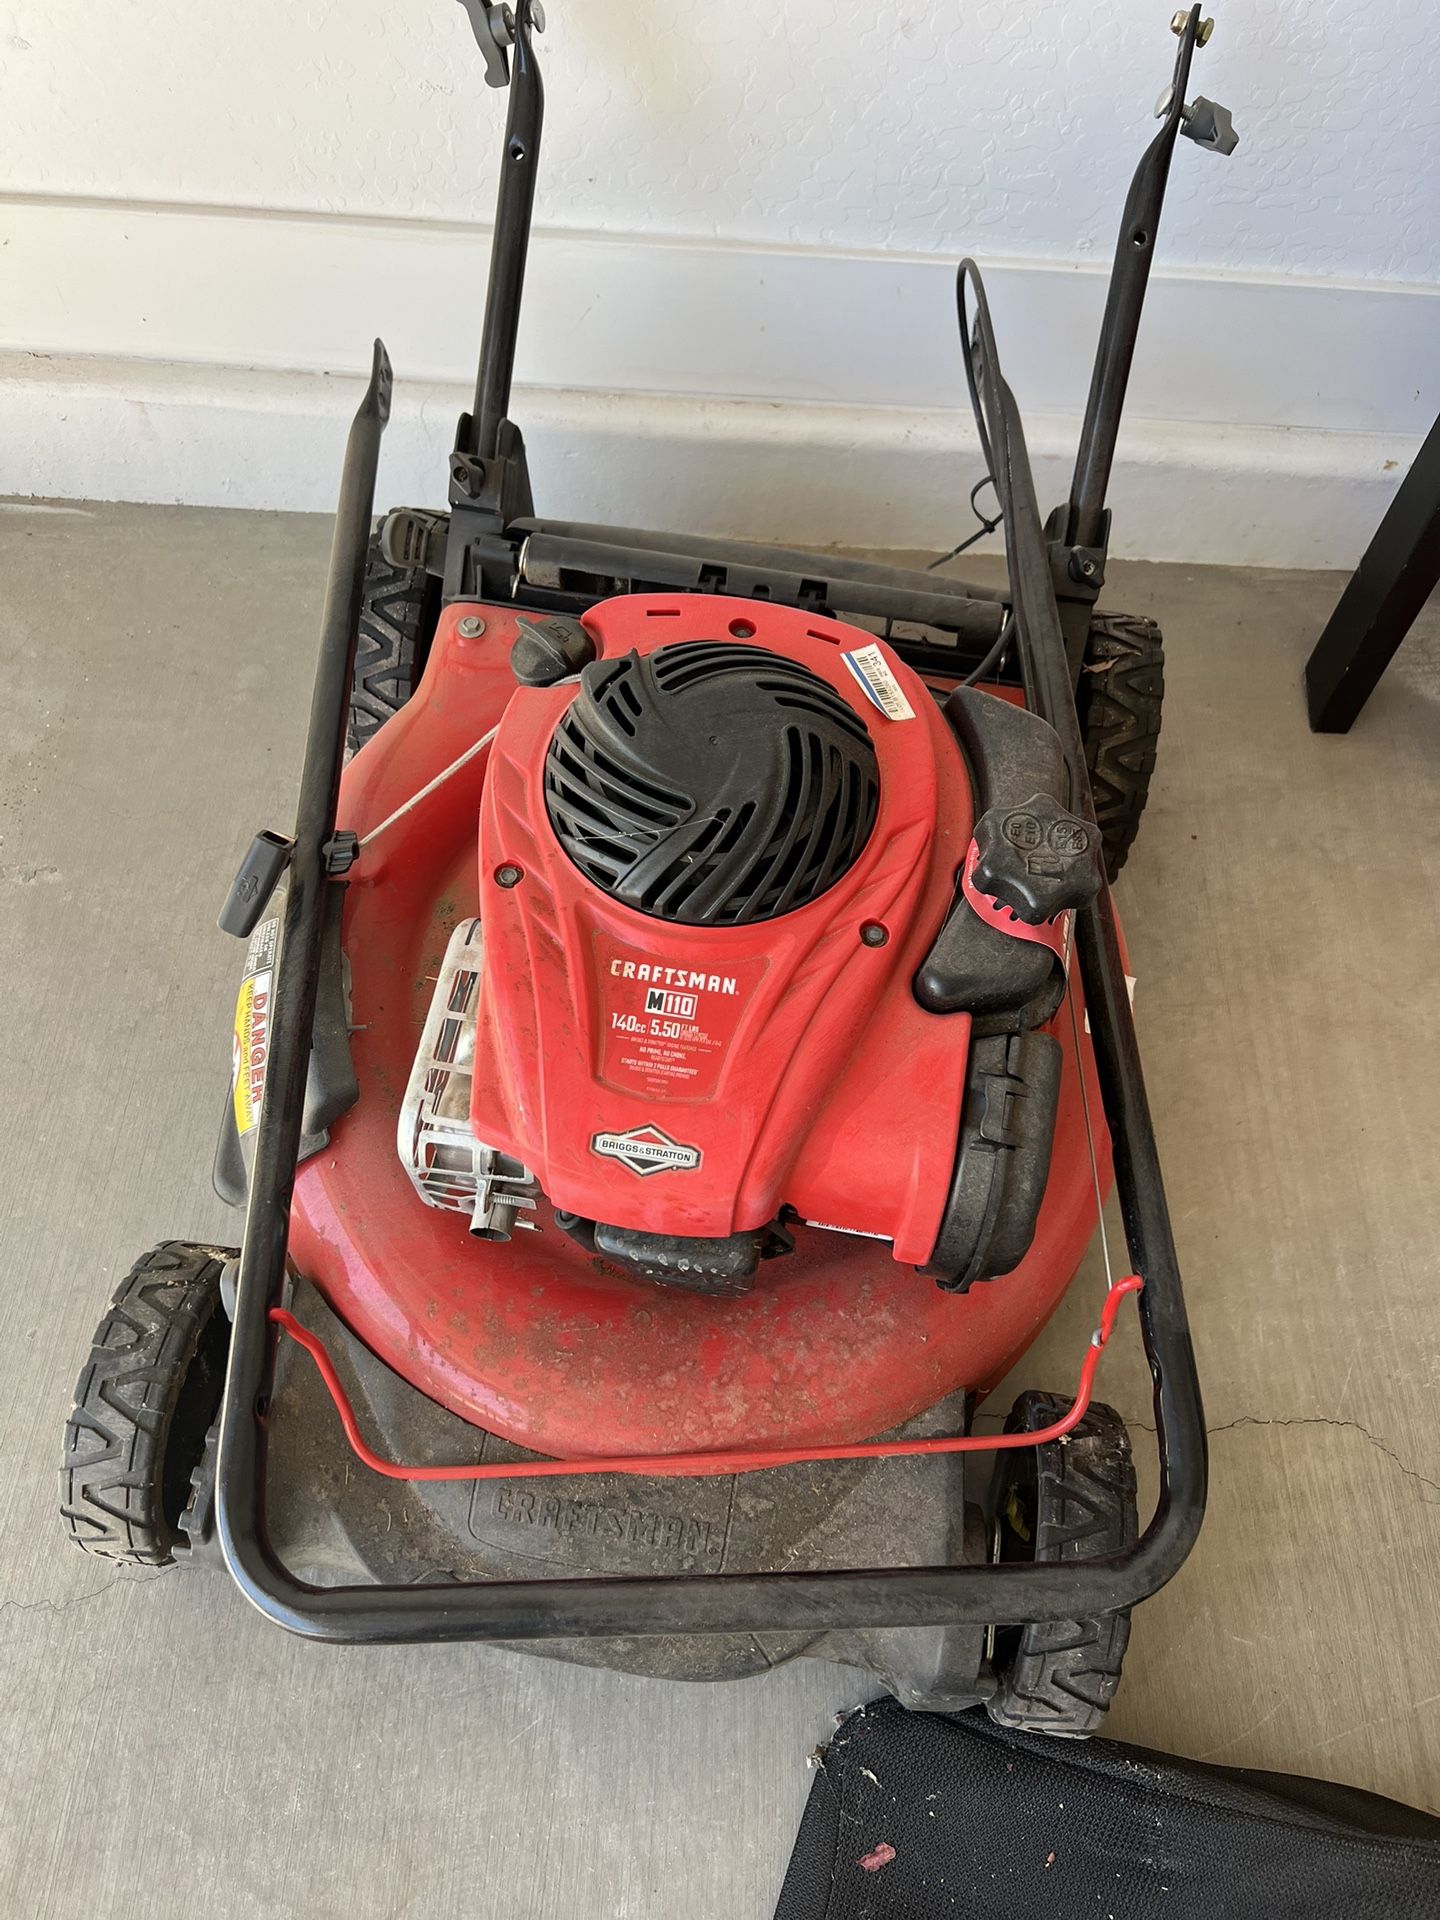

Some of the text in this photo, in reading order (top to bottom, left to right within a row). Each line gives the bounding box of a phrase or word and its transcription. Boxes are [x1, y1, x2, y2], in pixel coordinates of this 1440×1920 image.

[610, 959, 737, 995] CRAFTSMAN
[647, 990, 695, 1016] M110
[611, 1013, 647, 1034] 140cc
[650, 1018, 681, 1039] 5.50
[491, 1487, 713, 1554] CRAFTSMAN
